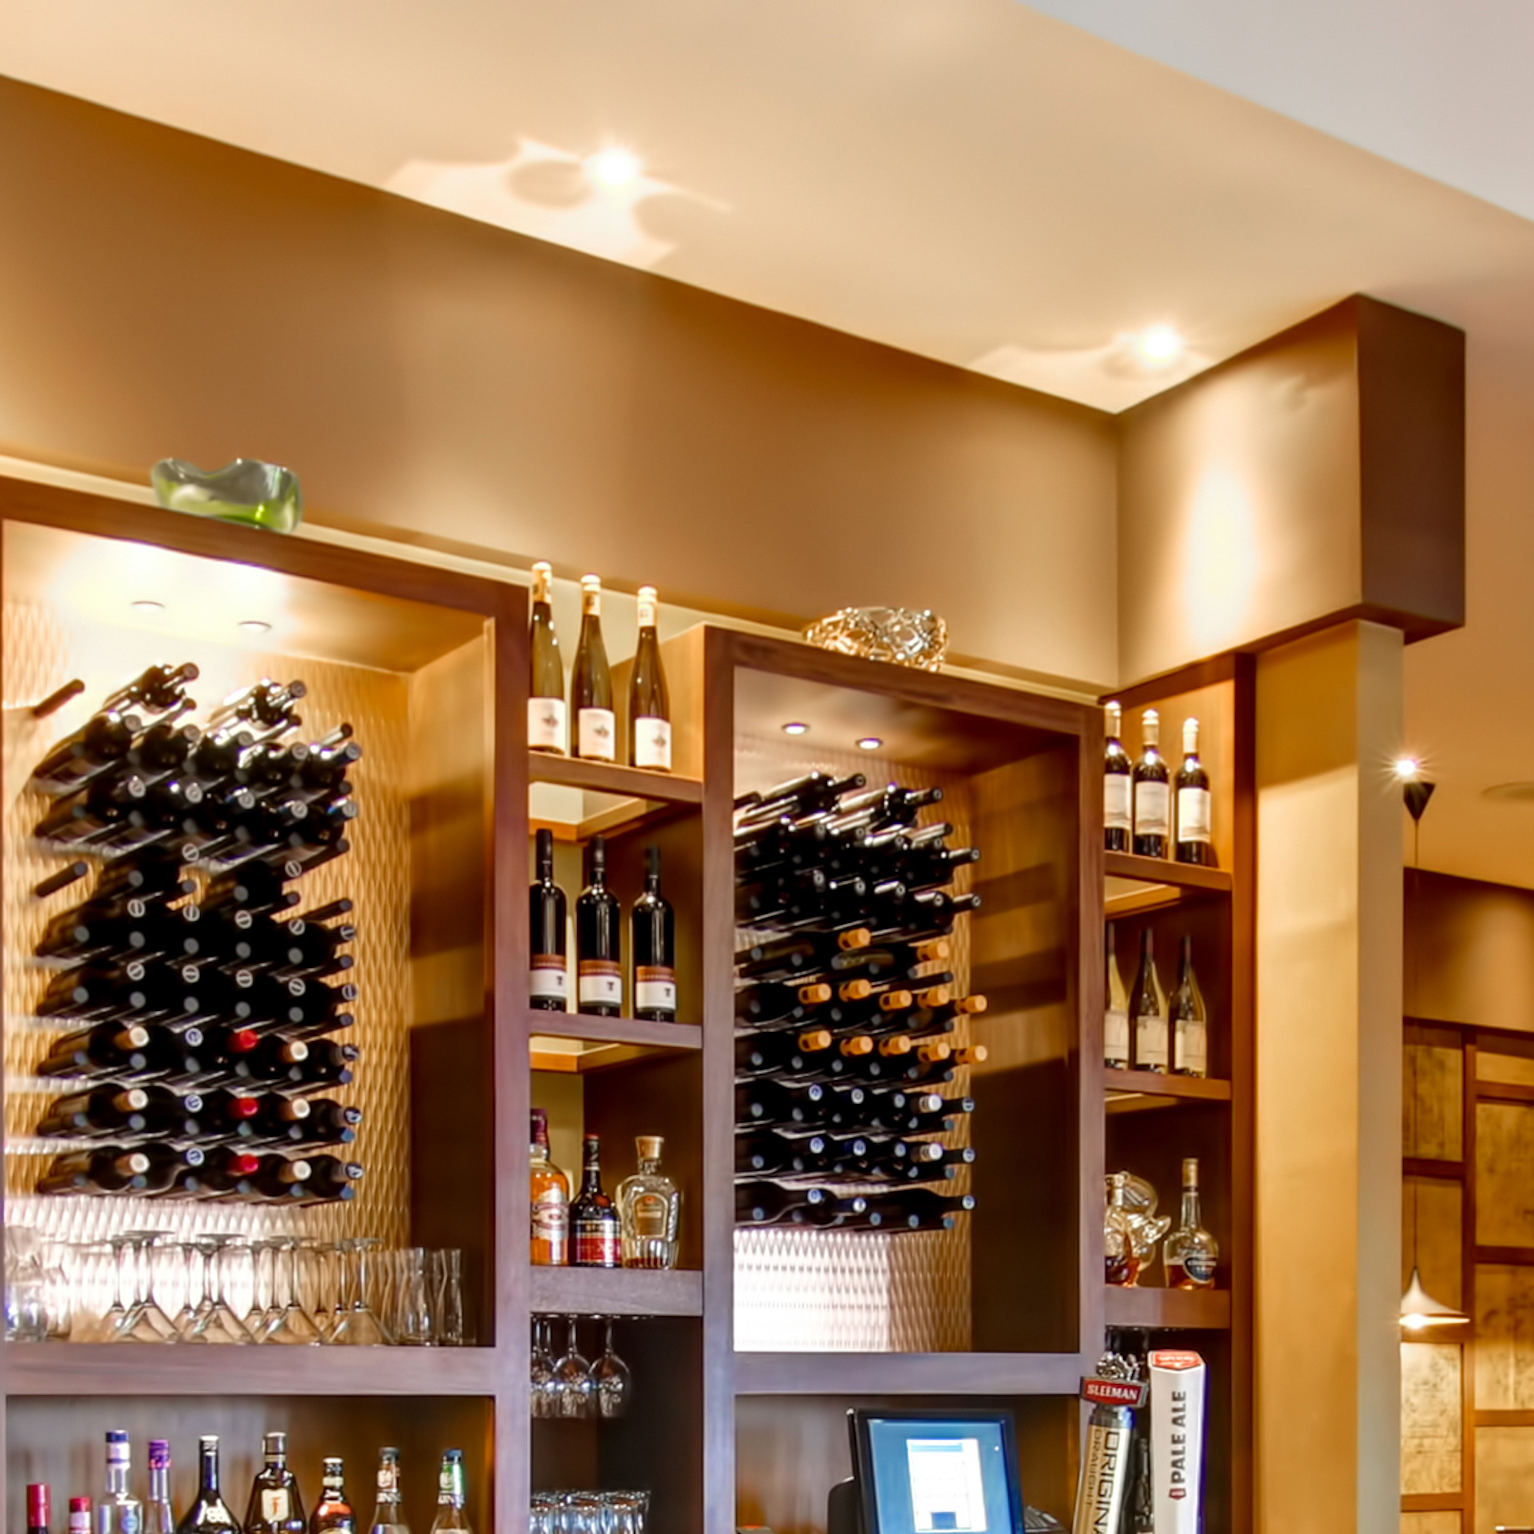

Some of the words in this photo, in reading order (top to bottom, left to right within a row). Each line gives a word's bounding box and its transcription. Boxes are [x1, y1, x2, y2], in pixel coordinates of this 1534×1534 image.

[1086, 1382, 1138, 1401] SLEEMAN
[1171, 1391, 1186, 1427] ALE
[1085, 1428, 1104, 1507] DRAUGHT
[1171, 1434, 1186, 1484] PALE
